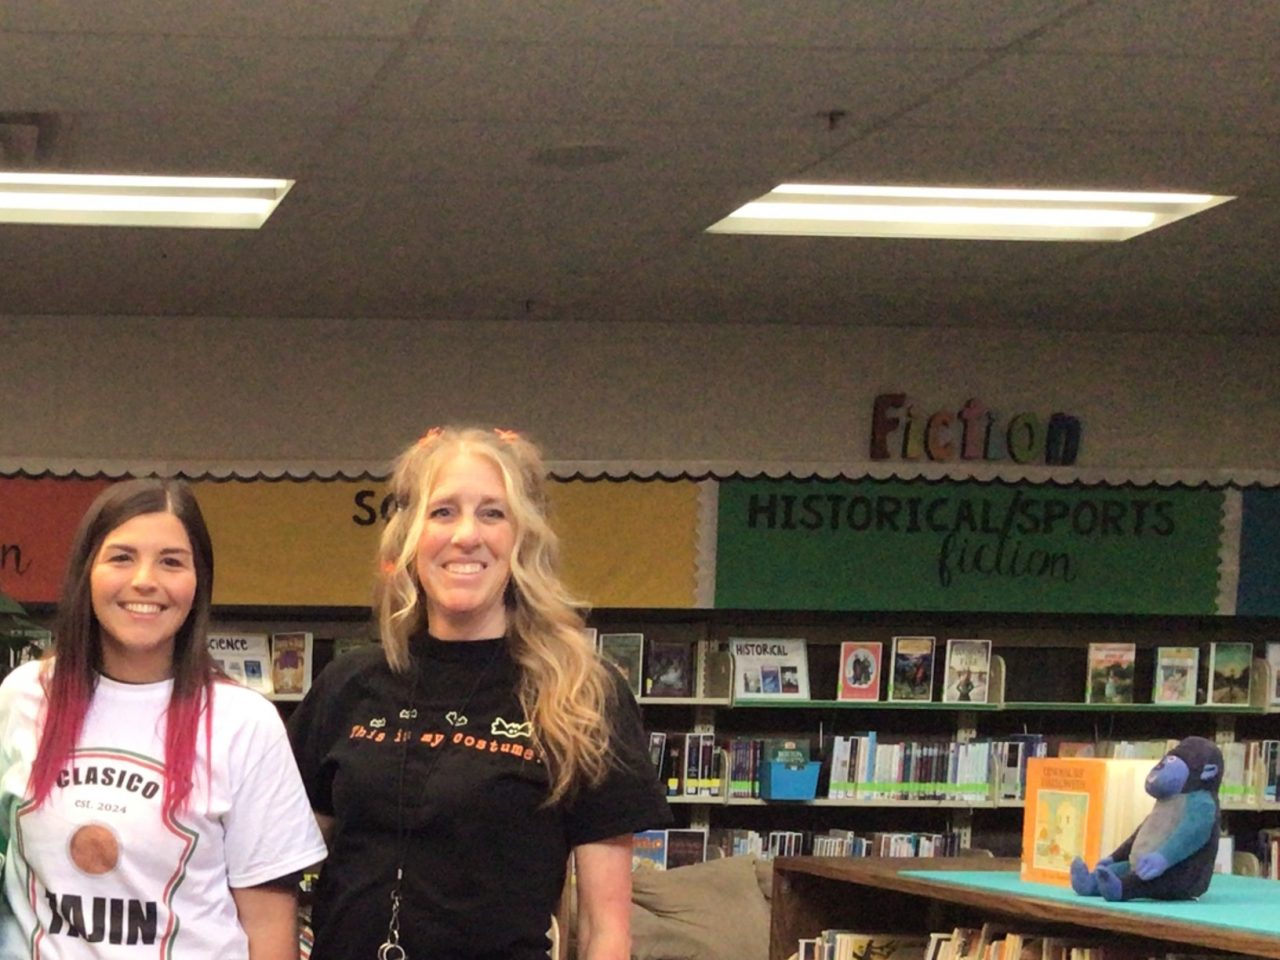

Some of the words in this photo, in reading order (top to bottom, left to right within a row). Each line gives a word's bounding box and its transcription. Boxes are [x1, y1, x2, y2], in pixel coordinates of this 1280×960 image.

[870, 393, 1081, 465] Fiction
[747, 492, 1176, 536] HISTORICAL/SPORTS
[936, 532, 1078, 588] fiction
[420, 732, 444, 747] my
[57, 766, 160, 800] CLASICO
[97, 802, 127, 815] 2024
